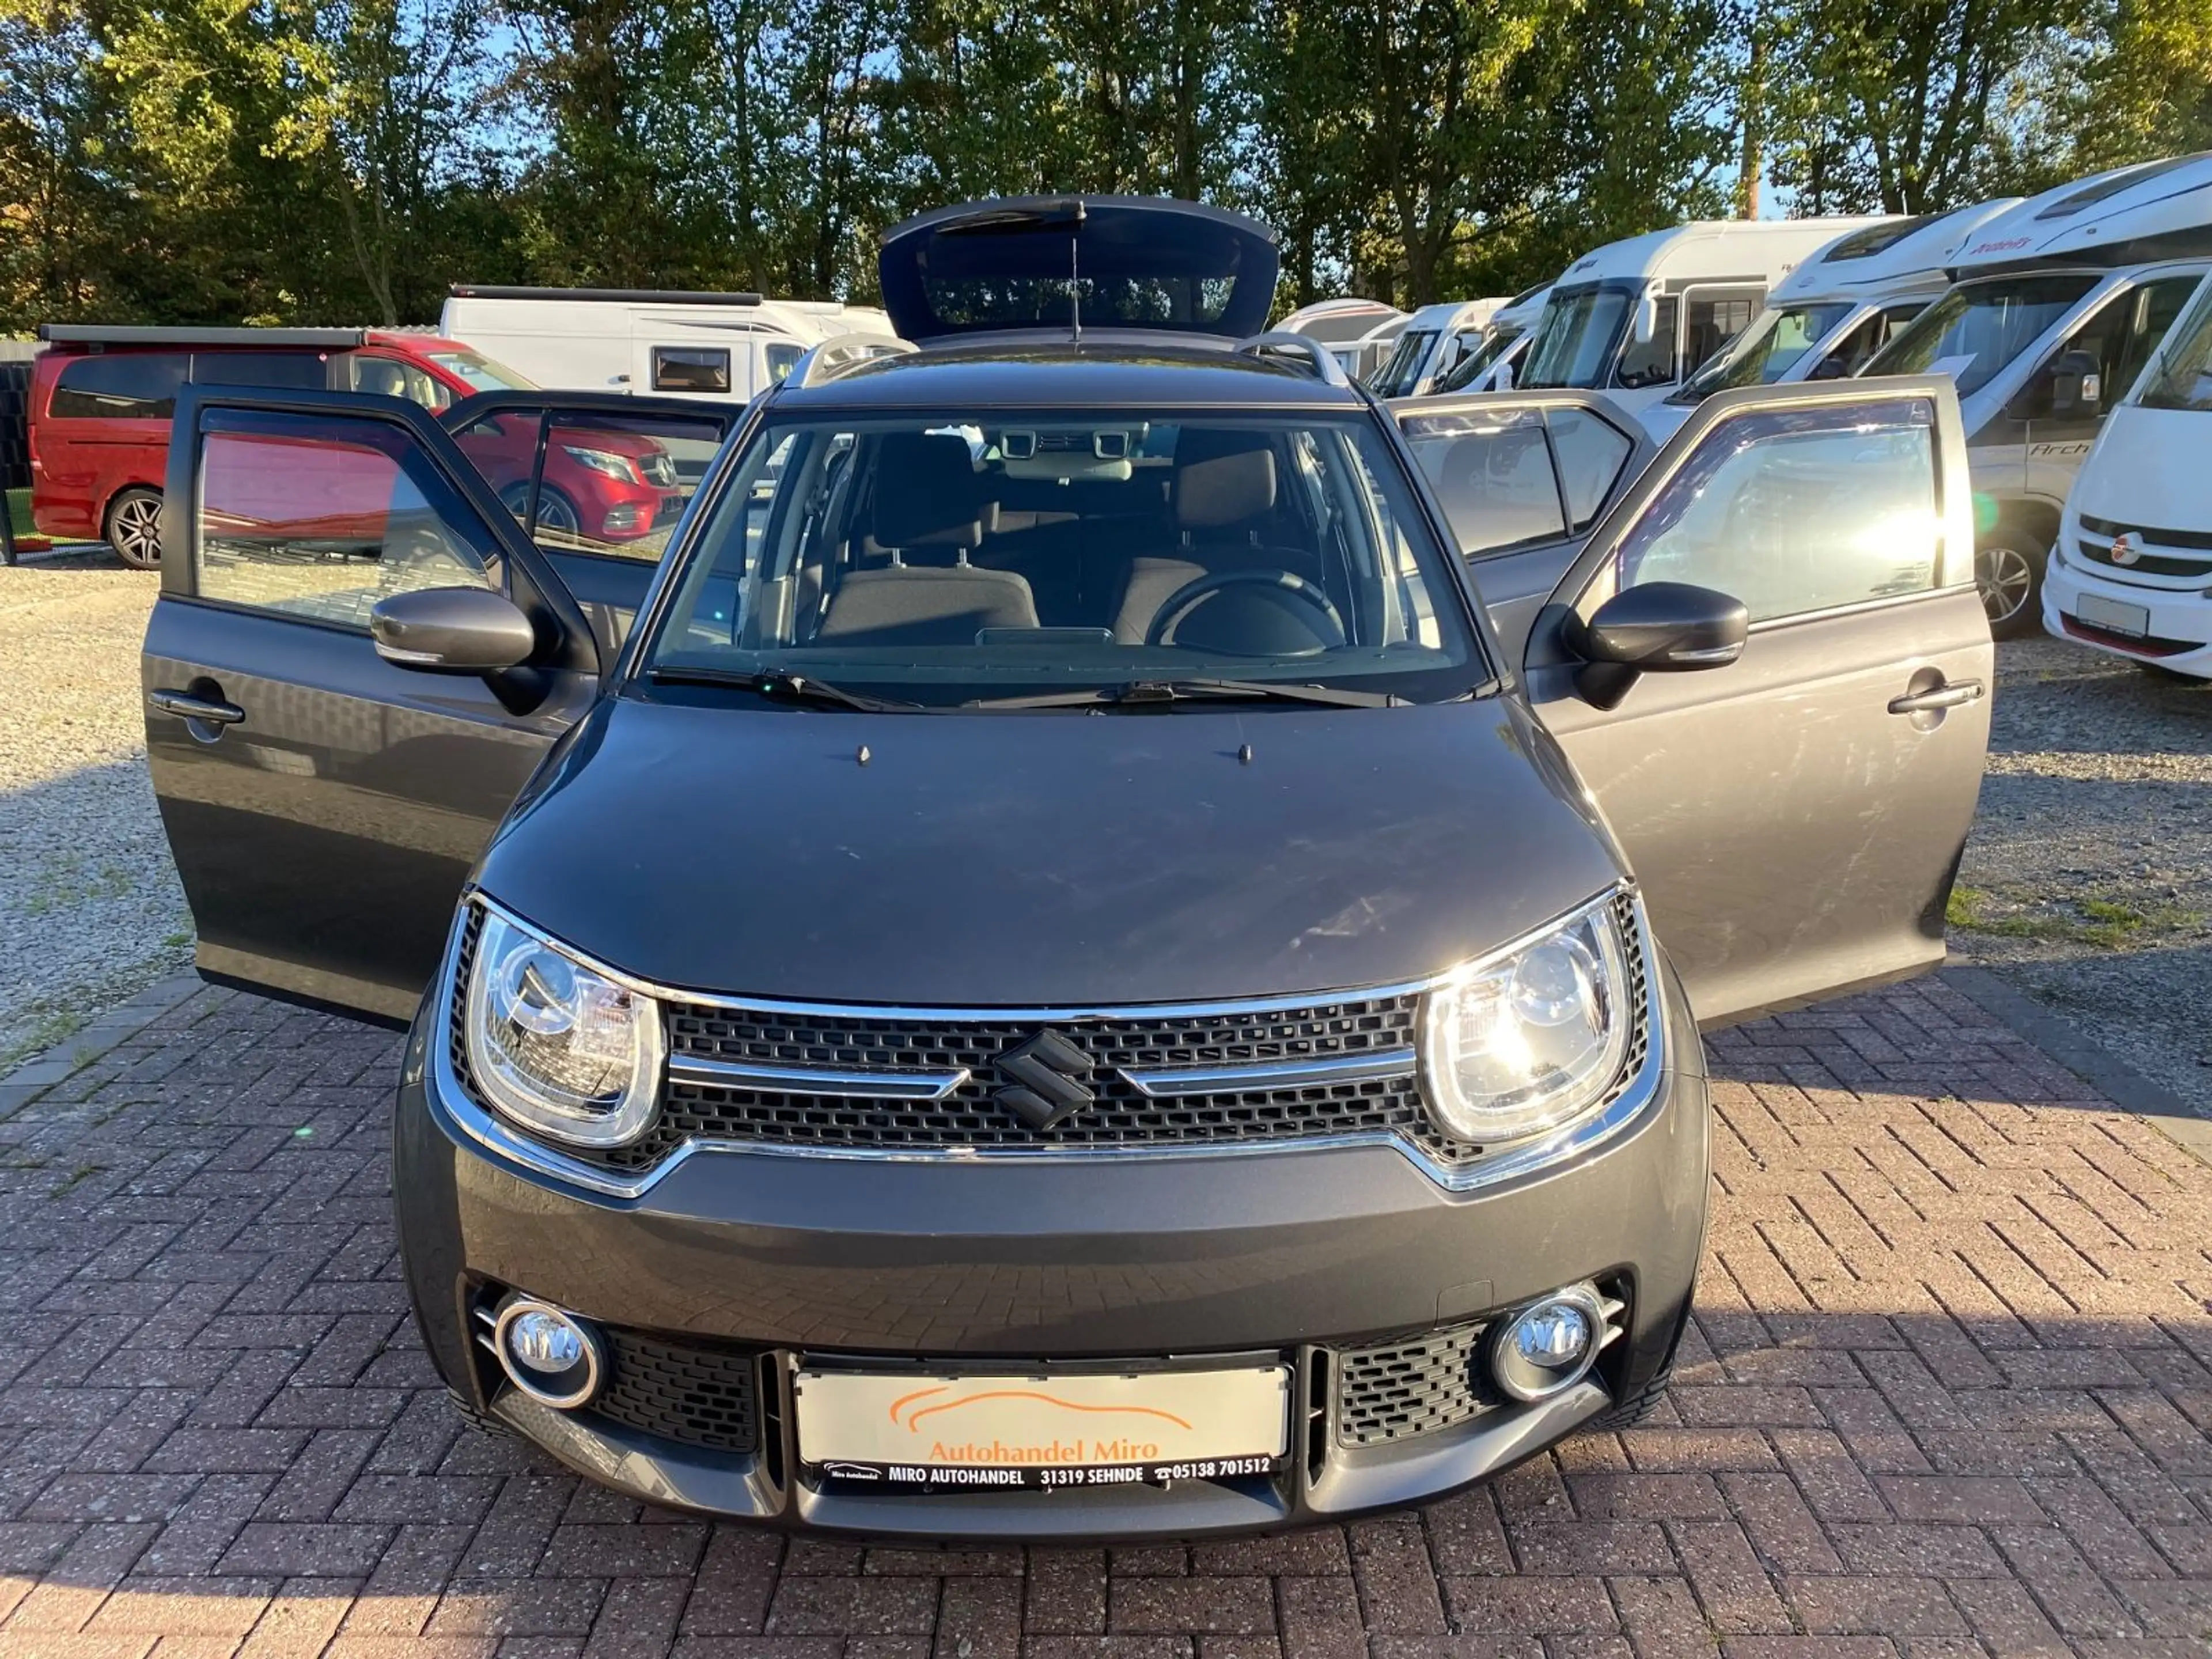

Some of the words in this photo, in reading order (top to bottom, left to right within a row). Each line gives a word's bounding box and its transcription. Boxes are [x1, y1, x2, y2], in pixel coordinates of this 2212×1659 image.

[929, 1440, 1083, 1463] Autohandel
[1094, 1438, 1158, 1461] Miro
[889, 1467, 926, 1482] MIRO
[930, 1468, 1025, 1484] AUTOHANDEL
[1040, 1469, 1084, 1484] 31319
[1088, 1467, 1143, 1483] SEHNDE
[1172, 1462, 1215, 1479] 05138
[1219, 1457, 1270, 1476] 701512
